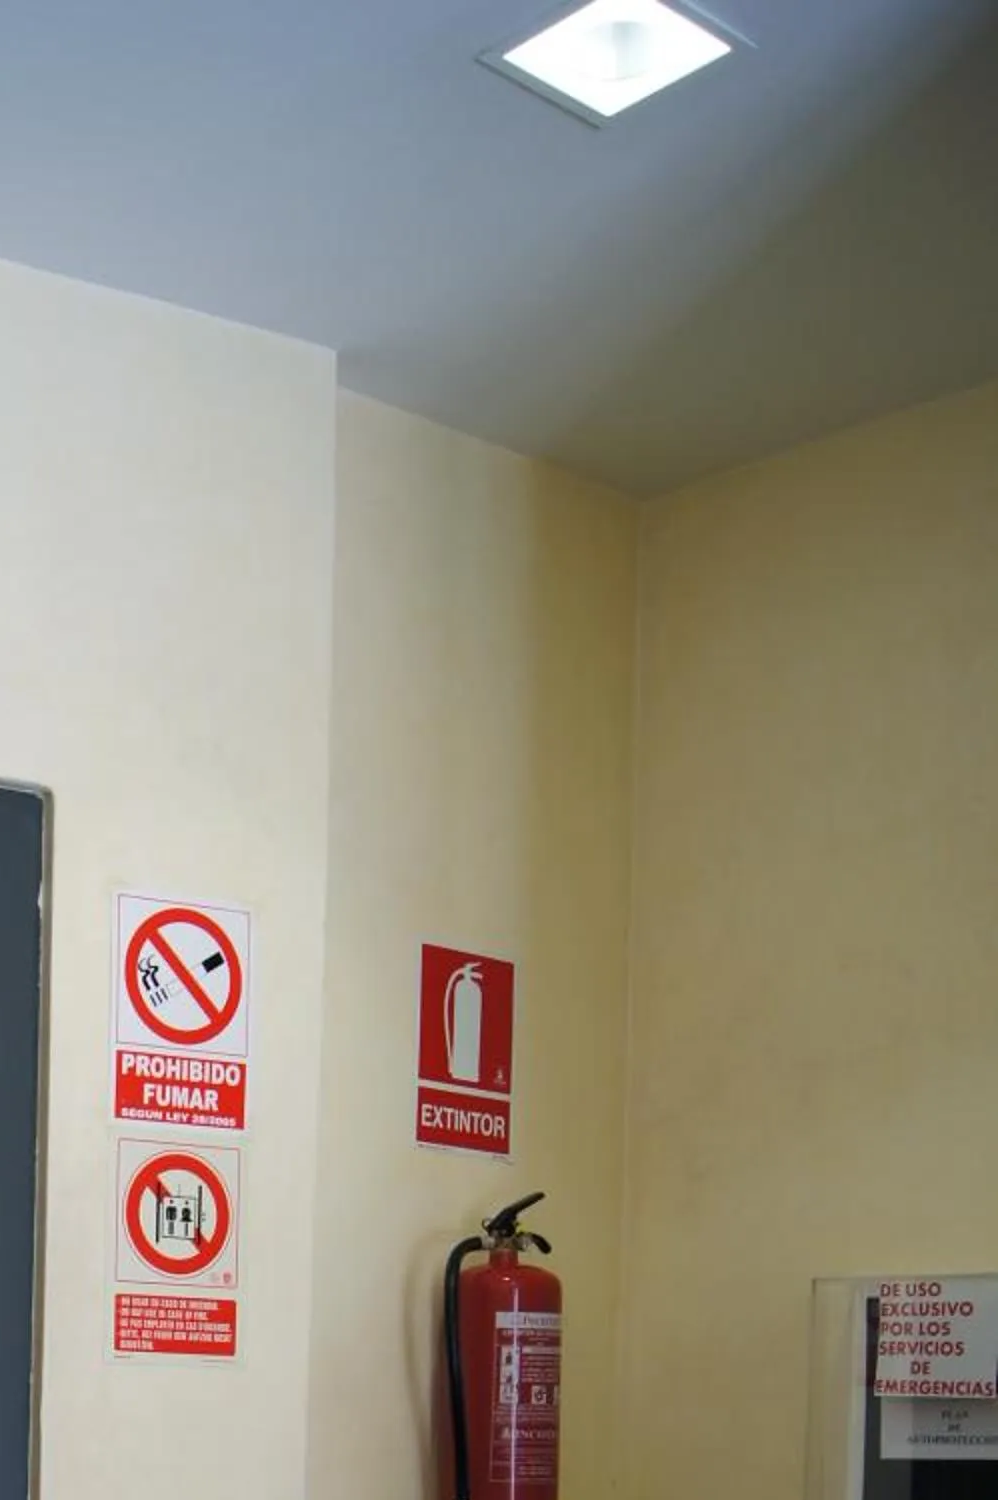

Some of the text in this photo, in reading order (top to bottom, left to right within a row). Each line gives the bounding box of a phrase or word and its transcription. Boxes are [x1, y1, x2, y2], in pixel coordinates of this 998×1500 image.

[121, 1053, 241, 1087] PROHIBIDO
[143, 1083, 219, 1112] FUMAR
[421, 1103, 506, 1139] EXTINTOR
[879, 1282, 942, 1298] DE USO
[880, 1301, 974, 1318] EXCLUSIVO
[880, 1321, 951, 1337] POR LOS
[878, 1341, 965, 1357] SERVICIOS
[910, 1361, 931, 1375] DE
[874, 1379, 994, 1397] EMERGENCIAS
